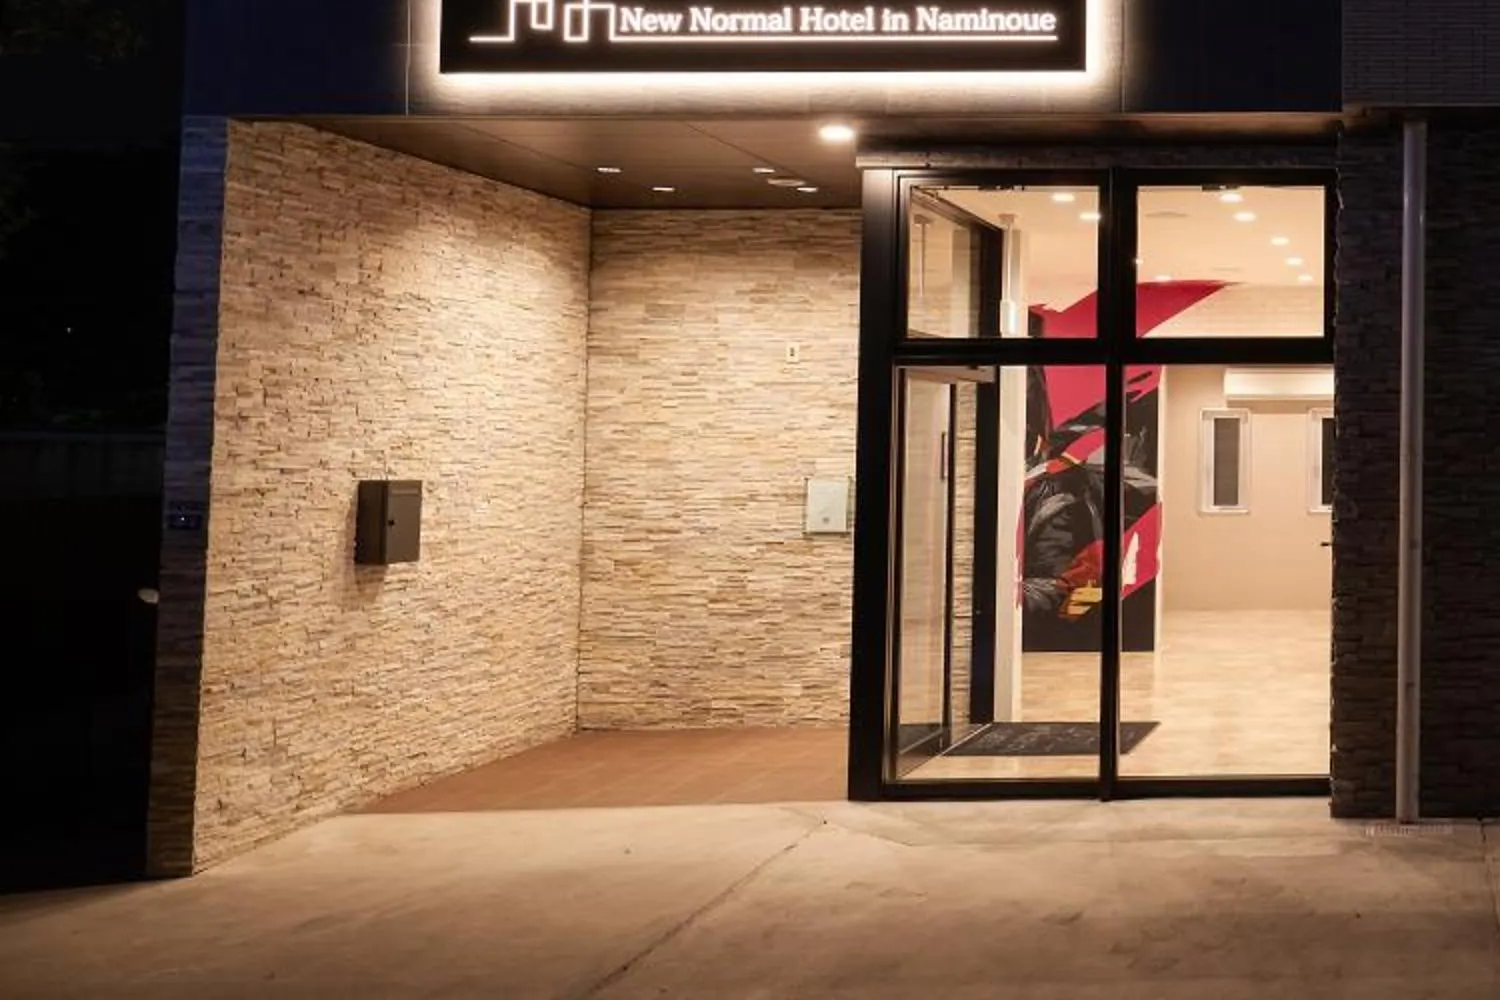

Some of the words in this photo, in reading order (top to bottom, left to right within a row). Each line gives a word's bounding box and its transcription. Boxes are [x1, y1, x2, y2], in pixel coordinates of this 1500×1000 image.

[619, 6, 683, 32] New
[689, 6, 793, 32] Normal
[799, 6, 875, 32] Hotel
[881, 8, 910, 32] in
[915, 6, 1057, 32] Naminoue
